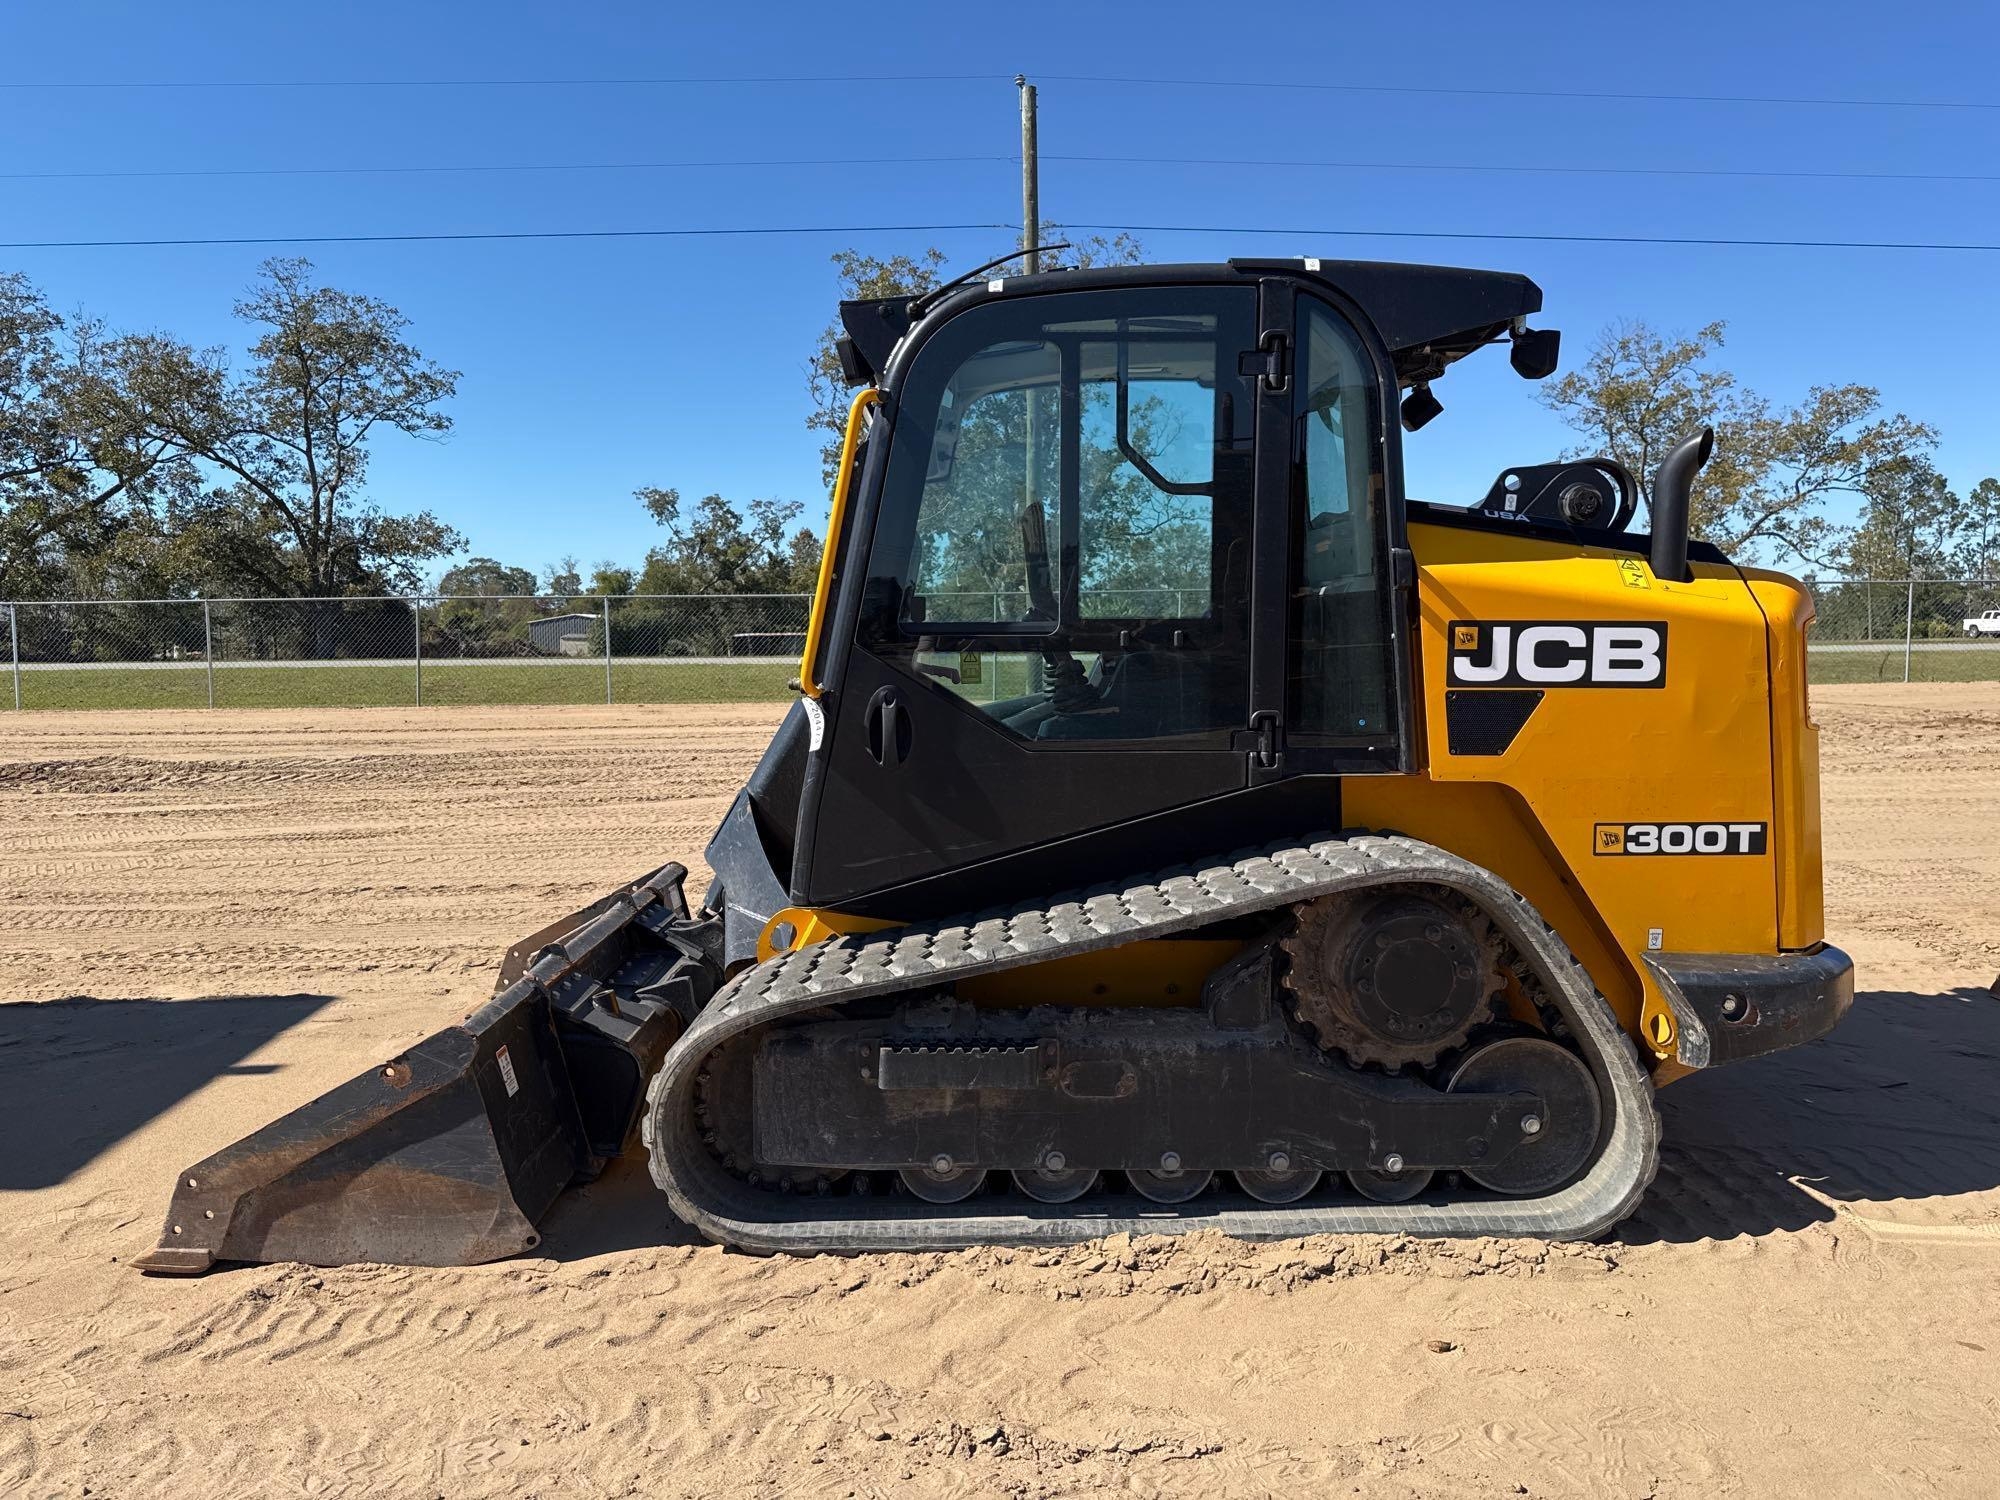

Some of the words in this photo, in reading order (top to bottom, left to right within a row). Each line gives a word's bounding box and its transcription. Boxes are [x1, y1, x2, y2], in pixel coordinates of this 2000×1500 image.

[1484, 510, 1530, 522] USA
[1454, 626, 1660, 682] JCB
[1603, 832, 1620, 846] JCB
[1626, 824, 1761, 853] 300T
